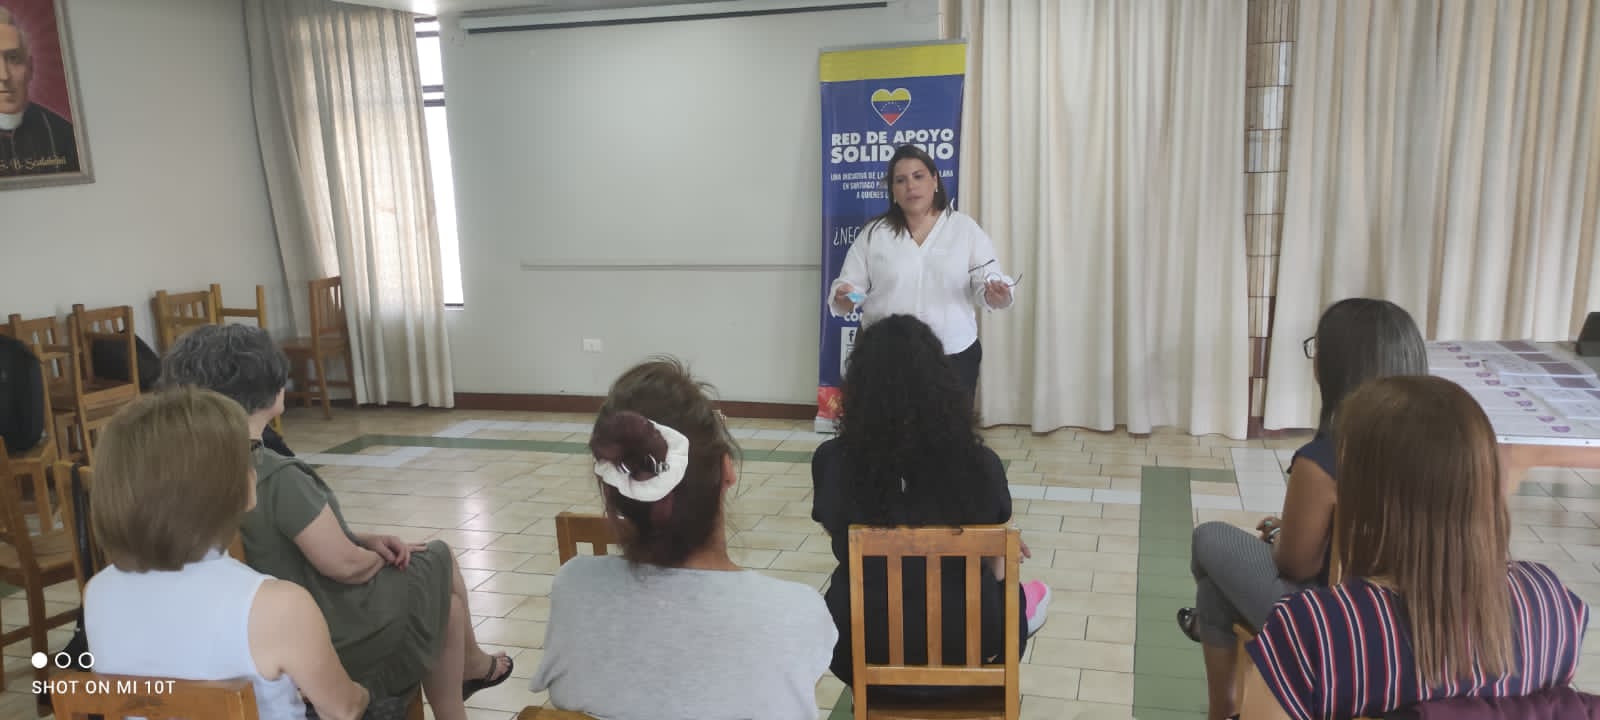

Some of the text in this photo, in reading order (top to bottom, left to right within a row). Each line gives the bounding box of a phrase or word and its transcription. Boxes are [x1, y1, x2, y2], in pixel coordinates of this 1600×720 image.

[831, 128, 954, 147] RED DE APOYO
[831, 142, 954, 164] SOLIDIO
[868, 171, 876, 179] DE
[850, 181, 875, 189] SANTIAGO
[861, 190, 884, 199] QUIENES
